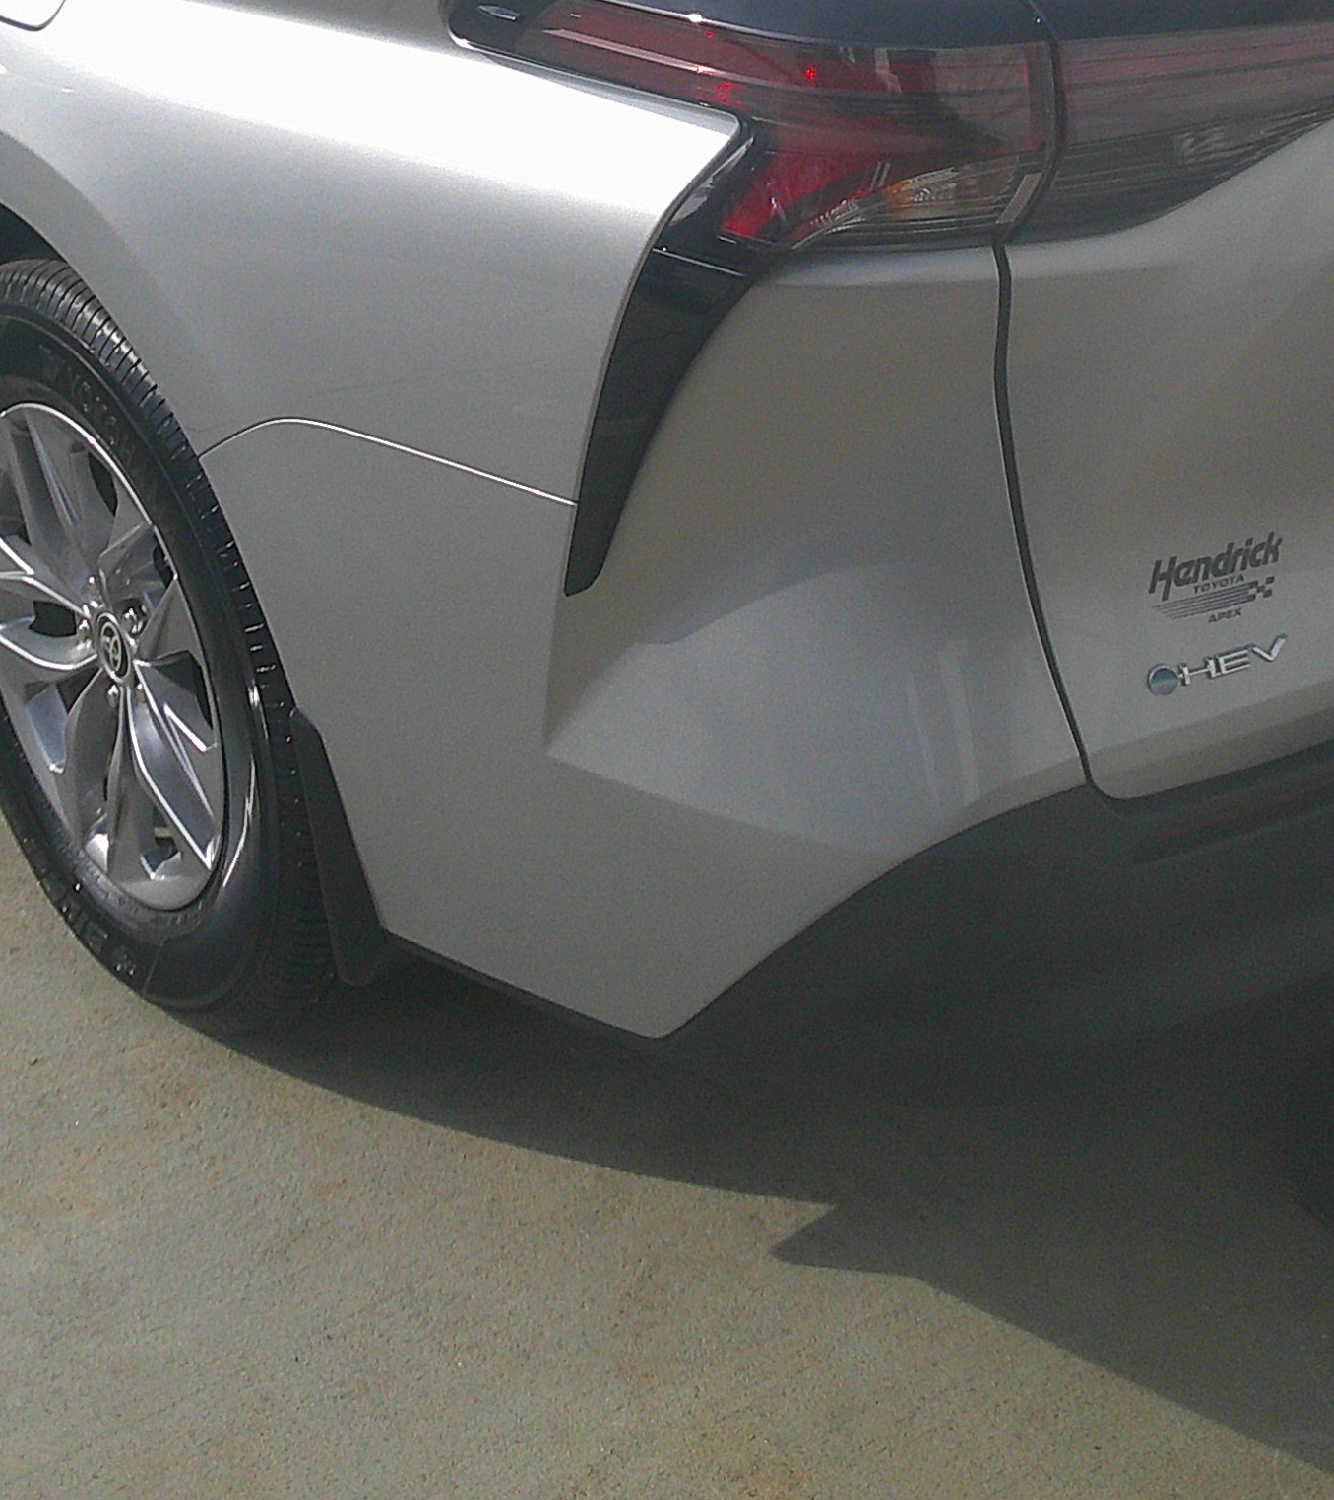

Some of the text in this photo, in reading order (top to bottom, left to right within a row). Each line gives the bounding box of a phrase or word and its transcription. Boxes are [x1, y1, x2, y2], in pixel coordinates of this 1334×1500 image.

[1148, 532, 1283, 601] Hendrick
[1193, 574, 1244, 594] TOYOTA
[1208, 607, 1242, 623] APEX
[1178, 633, 1288, 687] HEV
